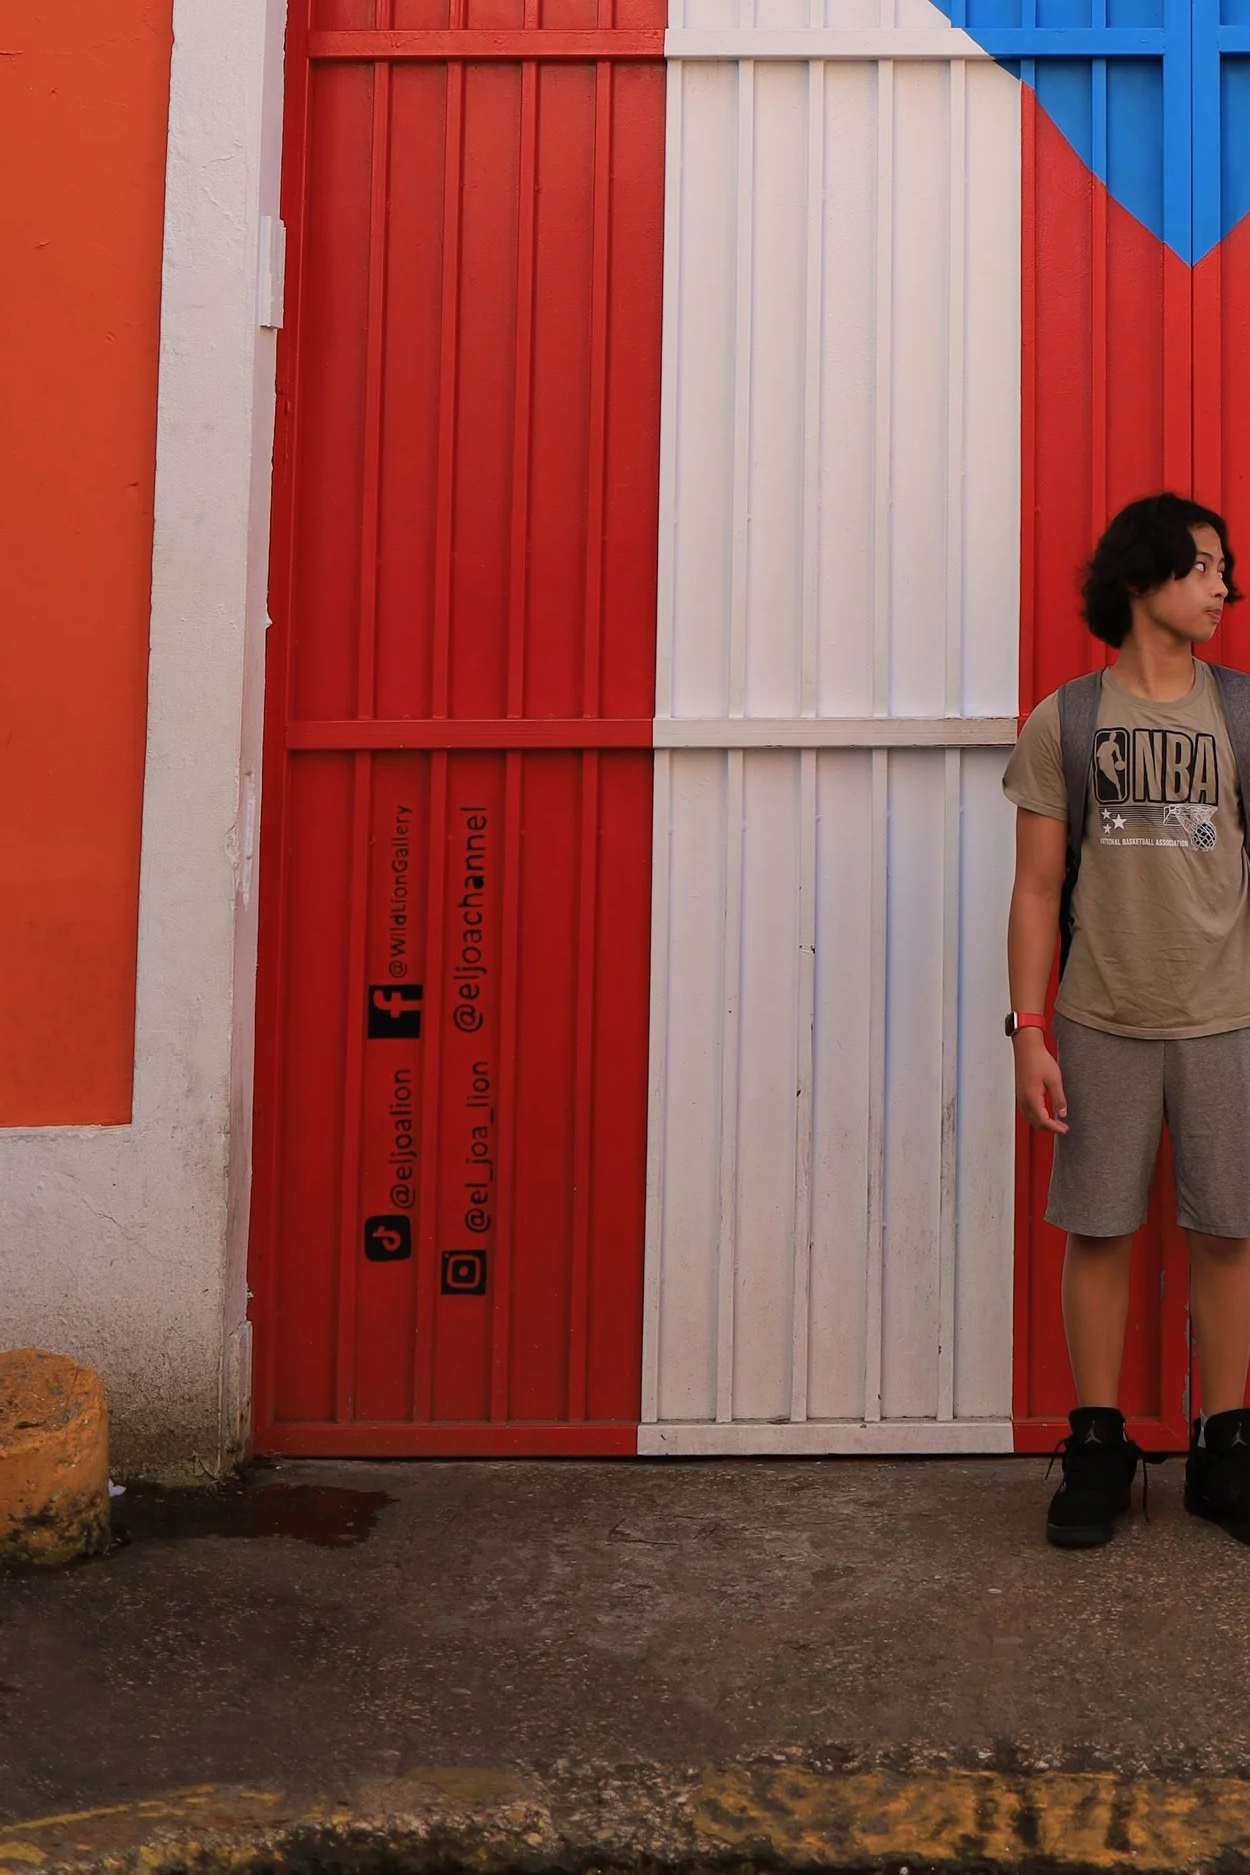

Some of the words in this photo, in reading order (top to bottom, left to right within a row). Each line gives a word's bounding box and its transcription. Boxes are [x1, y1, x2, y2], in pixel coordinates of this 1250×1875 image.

[1132, 728, 1219, 807] NBA
[388, 805, 412, 979] @WildLionGallery
[453, 806, 487, 1033] @eljoachannel
[388, 1069, 417, 1209] @eljoalion
[464, 1061, 494, 1233] @el_joa_lion
